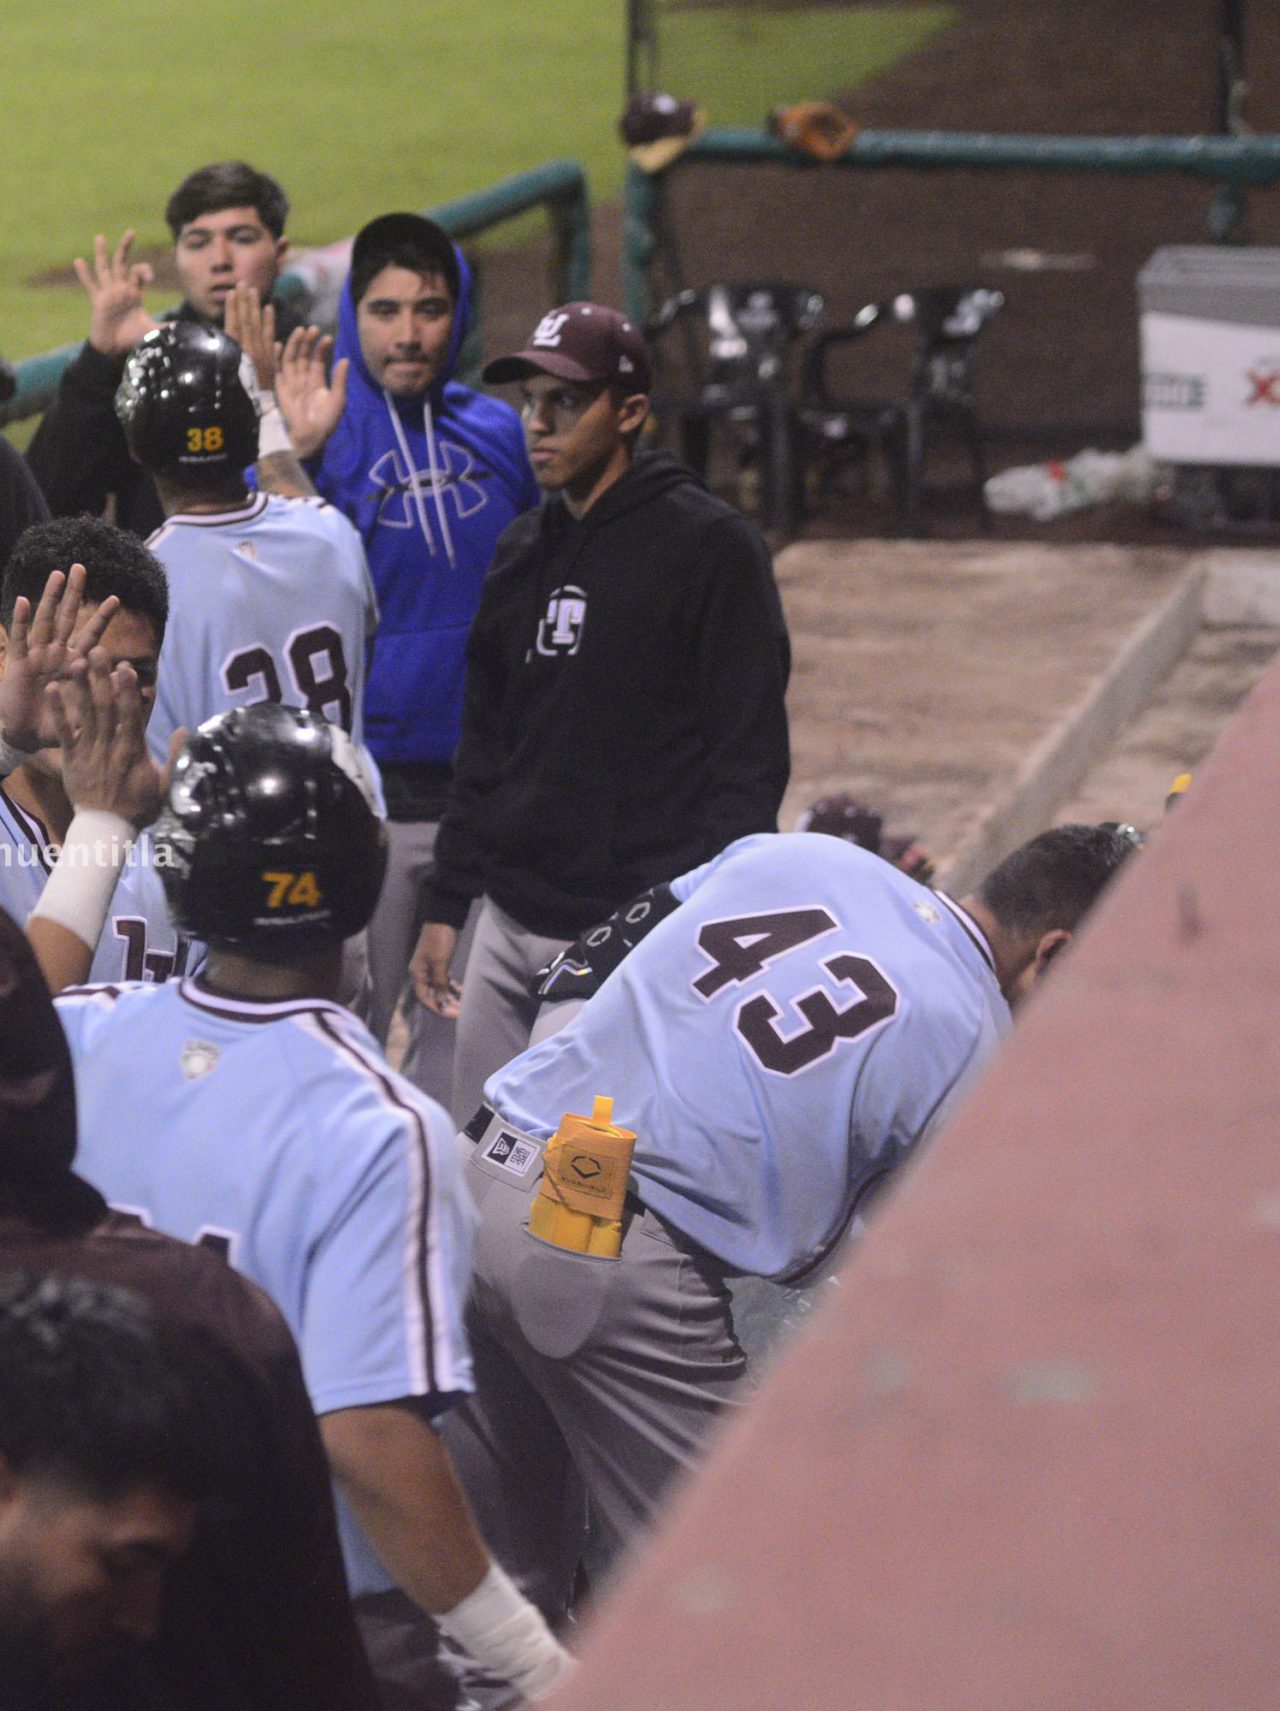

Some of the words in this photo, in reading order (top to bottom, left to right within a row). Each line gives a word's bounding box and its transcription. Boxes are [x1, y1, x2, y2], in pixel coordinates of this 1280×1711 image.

[186, 426, 225, 453] 38
[261, 871, 322, 909] 74
[689, 904, 900, 1079] 43
